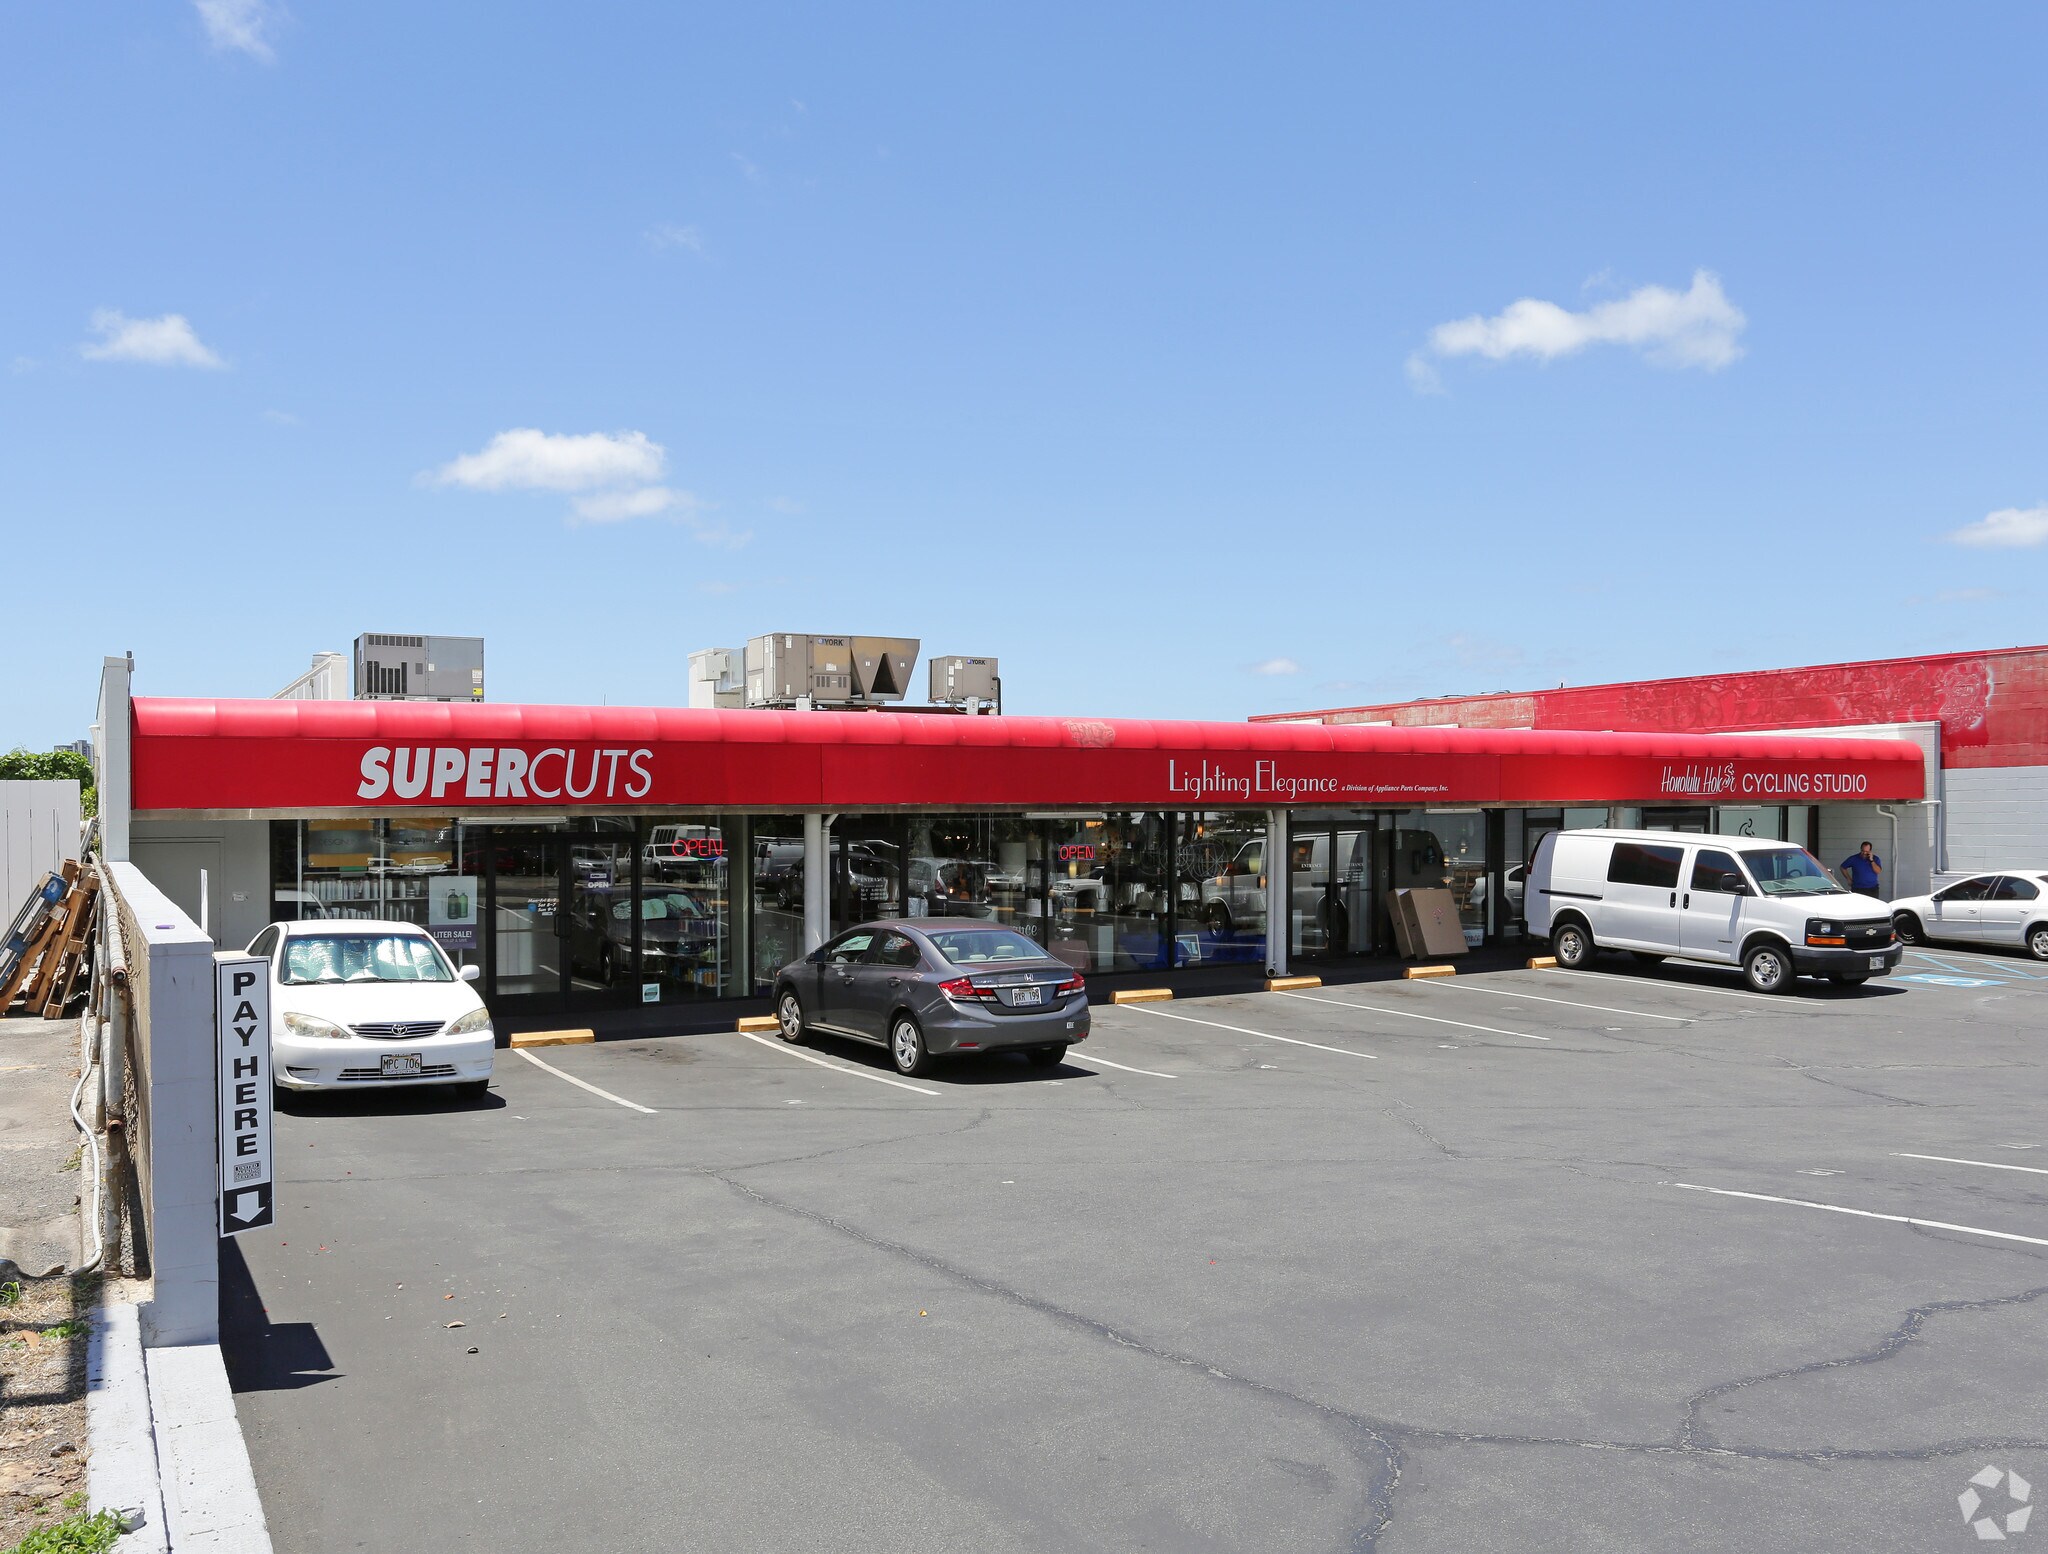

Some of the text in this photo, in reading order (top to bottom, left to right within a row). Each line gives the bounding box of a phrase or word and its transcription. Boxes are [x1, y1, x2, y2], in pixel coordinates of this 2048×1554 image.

[824, 638, 844, 647] YORK
[971, 658, 986, 666] YORK
[357, 746, 654, 800] SUPERCUTS
[1169, 759, 1338, 800] Lighting Elegance
[1661, 765, 1701, 793] Honolulu
[1742, 773, 1810, 793] CYCLING
[1813, 773, 1867, 793] STUDIO
[1346, 784, 1368, 792] Division
[1368, 784, 1374, 793] of
[1374, 784, 1400, 793] Appliance
[1414, 785, 1439, 793] Company,
[672, 838, 723, 857] OPEN
[1059, 845, 1095, 860] OPEN
[588, 881, 609, 889] OPEN
[433, 930, 473, 939] LITER SALE!
[232, 971, 259, 1047] PAY
[233, 1055, 259, 1157] HERE
